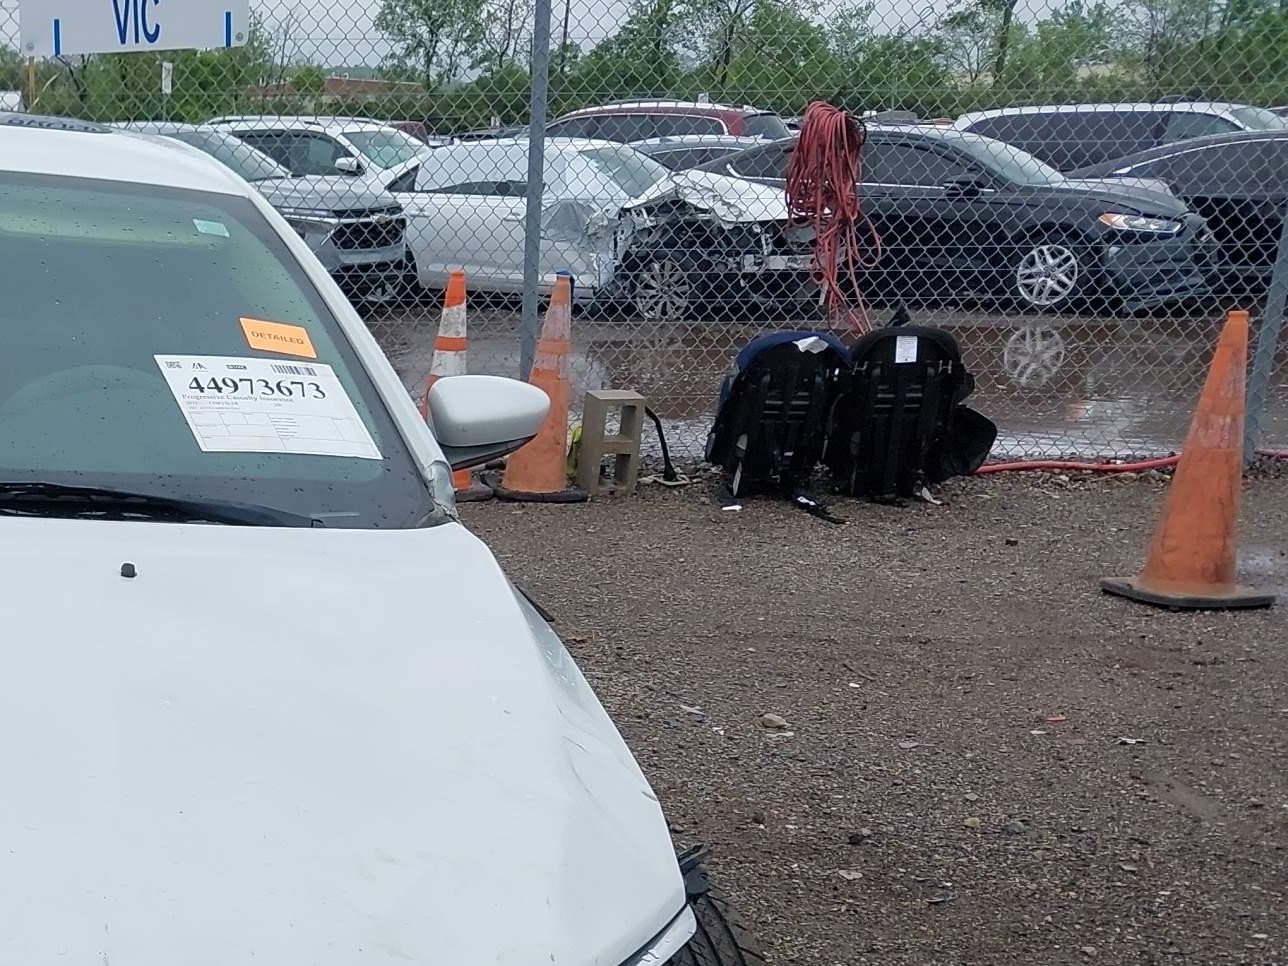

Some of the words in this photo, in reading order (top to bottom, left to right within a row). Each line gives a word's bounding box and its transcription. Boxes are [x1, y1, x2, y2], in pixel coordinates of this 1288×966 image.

[113, 0, 161, 44] VIC
[250, 330, 305, 346] DETAILED
[188, 376, 326, 399] 44973673
